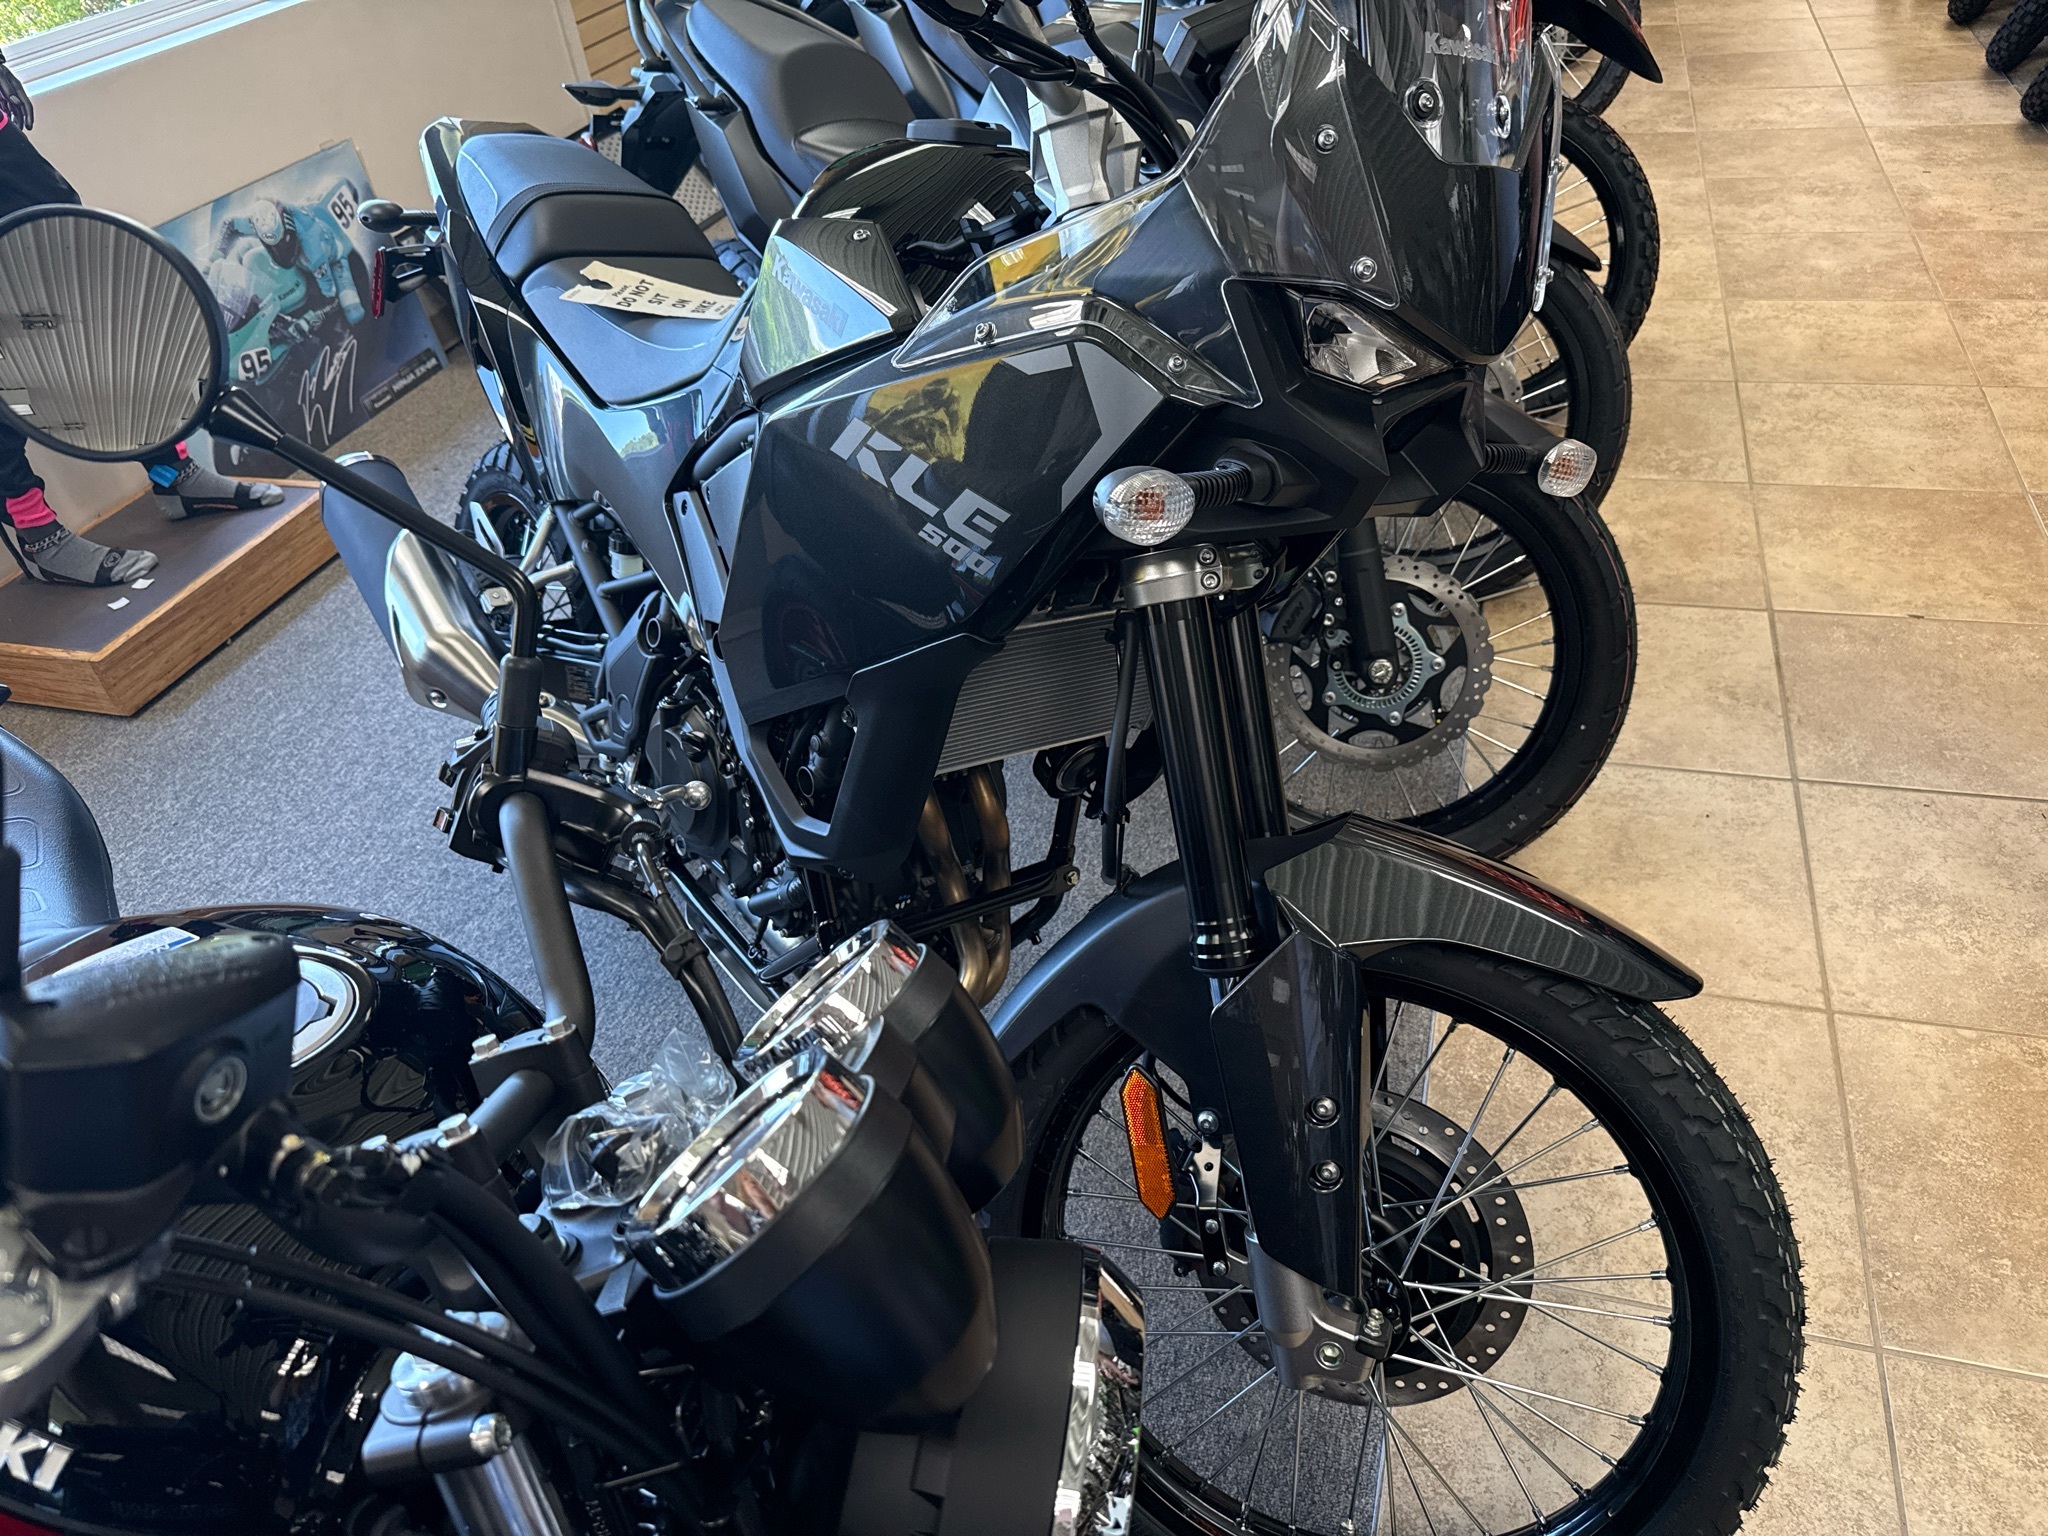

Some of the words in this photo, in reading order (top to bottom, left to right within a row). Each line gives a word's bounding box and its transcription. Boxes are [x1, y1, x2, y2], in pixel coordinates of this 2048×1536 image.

[331, 191, 355, 230] 95
[616, 296, 637, 308] DO
[629, 278, 655, 298] NOT
[647, 292, 669, 305] SIT
[671, 298, 692, 309] ON
[690, 299, 717, 314] BIKE
[771, 252, 849, 338] Kawasaki
[240, 348, 271, 381] 95
[830, 416, 1011, 551] KLE
[917, 522, 996, 576] 500
